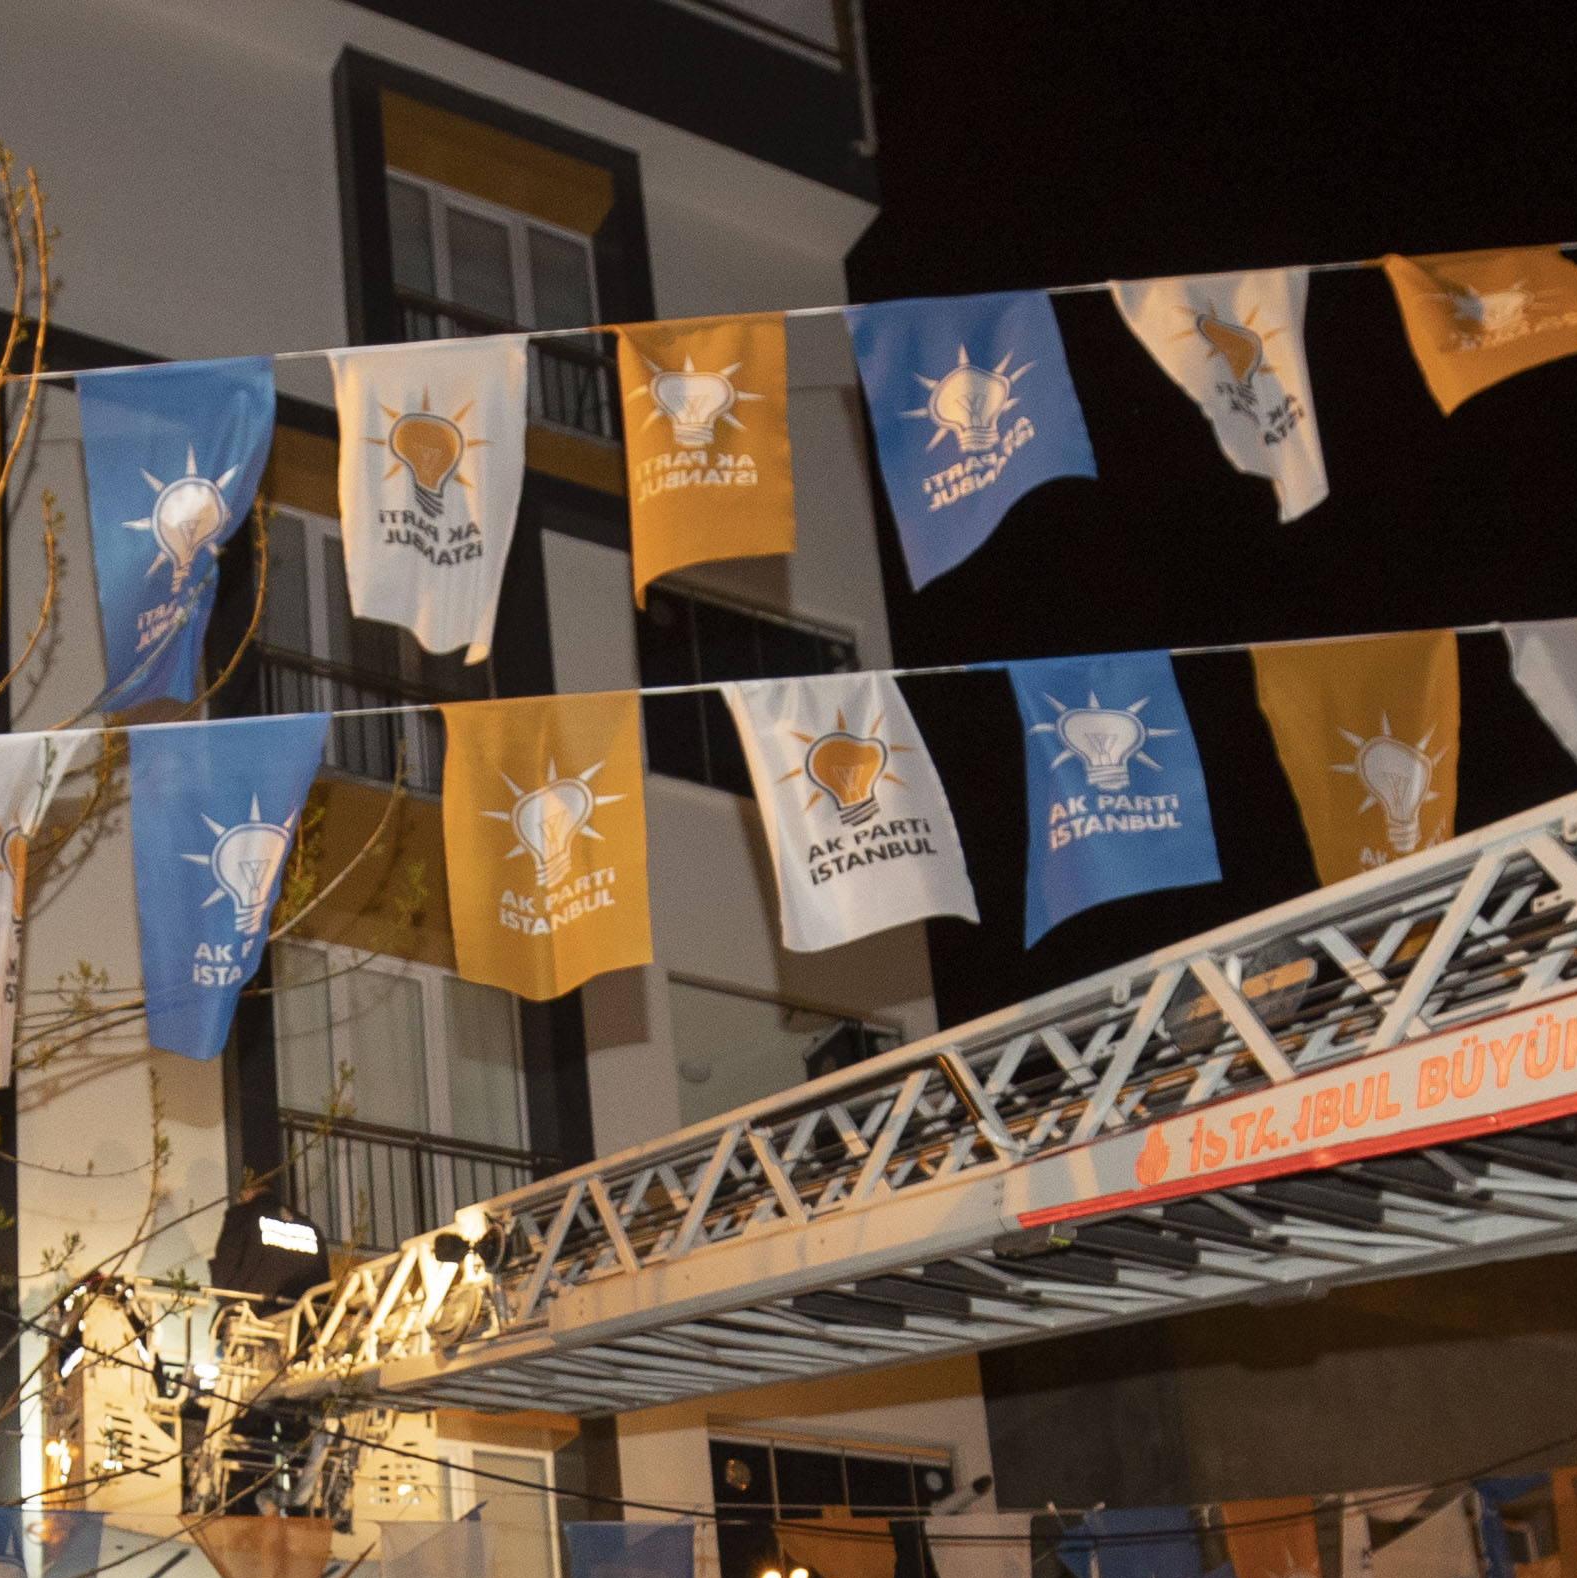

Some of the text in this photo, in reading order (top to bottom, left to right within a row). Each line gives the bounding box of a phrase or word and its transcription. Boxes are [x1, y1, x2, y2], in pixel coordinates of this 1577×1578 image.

[1049, 795, 1088, 826] AK
[808, 834, 846, 862] AK
[499, 889, 536, 910] AK
[193, 942, 235, 964] AK
